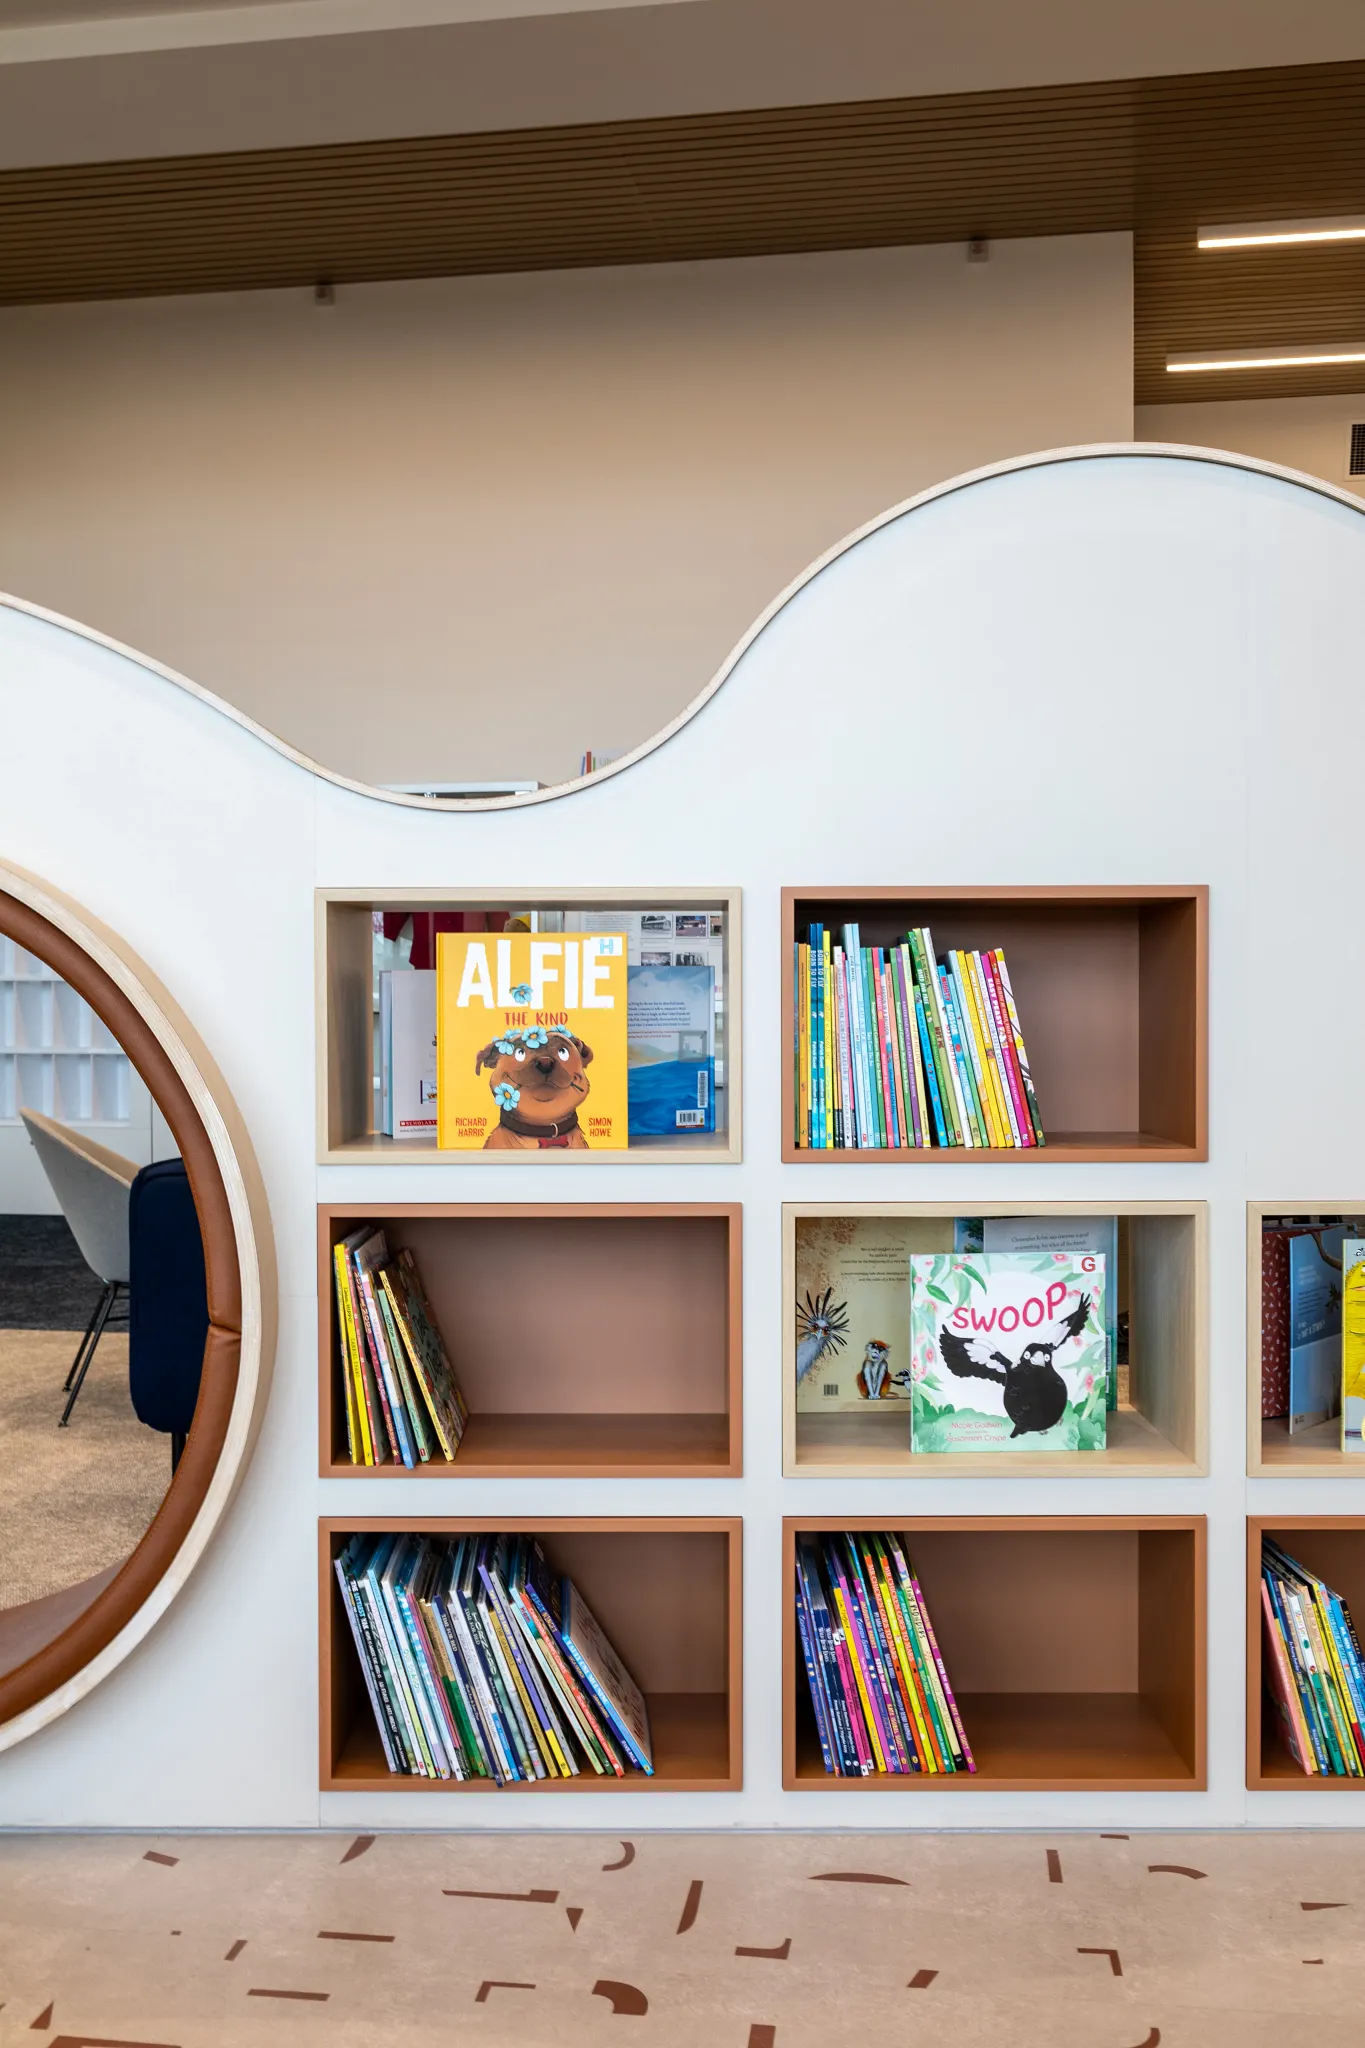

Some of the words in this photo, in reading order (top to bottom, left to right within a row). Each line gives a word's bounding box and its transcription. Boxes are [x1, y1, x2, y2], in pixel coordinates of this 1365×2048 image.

[600, 938, 613, 954] H
[456, 940, 614, 1009] ALFIE
[818, 967, 823, 975] TO
[941, 976, 951, 1001] MIGHTY
[946, 1004, 957, 1035] BLOSSOM
[987, 977, 996, 998] EASY
[992, 1000, 1003, 1025] PEASY
[505, 1012, 528, 1026] THE
[536, 1012, 568, 1026] KIND
[938, 1040, 944, 1049] ME
[456, 1118, 488, 1126] RICHARD
[588, 1118, 612, 1126] SIMON
[458, 1129, 485, 1137] HARRIS
[590, 1128, 612, 1137] HOWE
[1082, 1256, 1096, 1272] G
[952, 1282, 1067, 1334] SWOOP
[867, 1563, 875, 1575] MR
[883, 1565, 891, 1577] MR
[870, 1575, 884, 1608] CHICKEN
[887, 1577, 900, 1609] CHICKEN
[905, 1585, 915, 1602] TINY
[349, 1580, 357, 1592] THE
[353, 1592, 365, 1617] LITTLEST
[360, 1617, 368, 1630] YAK
[859, 1600, 872, 1629] JACQUELINE
[463, 1607, 472, 1620] TIME
[468, 1621, 476, 1633] FOR
[472, 1633, 480, 1645] BED
[879, 1608, 889, 1628] GOES
[896, 1610, 906, 1630] GOES
[364, 1602, 386, 1666] TORNADO
[441, 1613, 449, 1627] TIME
[445, 1628, 453, 1639] FOR
[449, 1639, 457, 1652] BED
[527, 1607, 546, 1636] CHRISTMAS
[543, 1635, 557, 1655] ALWAYS
[554, 1654, 567, 1673] COMES
[867, 1629, 877, 1649] HARVEY
[885, 1629, 892, 1639] TO
[901, 1630, 909, 1641] TO
[1343, 1610, 1352, 1626] Blue
[1349, 1629, 1361, 1655] Flower
[470, 1611, 497, 1675] TORNADO
[888, 1640, 898, 1660] MARS
[904, 1641, 914, 1661] MARS
[1339, 1626, 1347, 1636] MR.
[1343, 1636, 1351, 1649] MEN
[1347, 1650, 1356, 1666] LITTLE
[1352, 1666, 1360, 1679] MISS
[886, 1703, 894, 1716] KATE
[889, 1716, 899, 1734] ISOBEL
[949, 1702, 958, 1715] KATE
[959, 1734, 969, 1750] SCOTT
[894, 1734, 903, 1750] SCOTT
